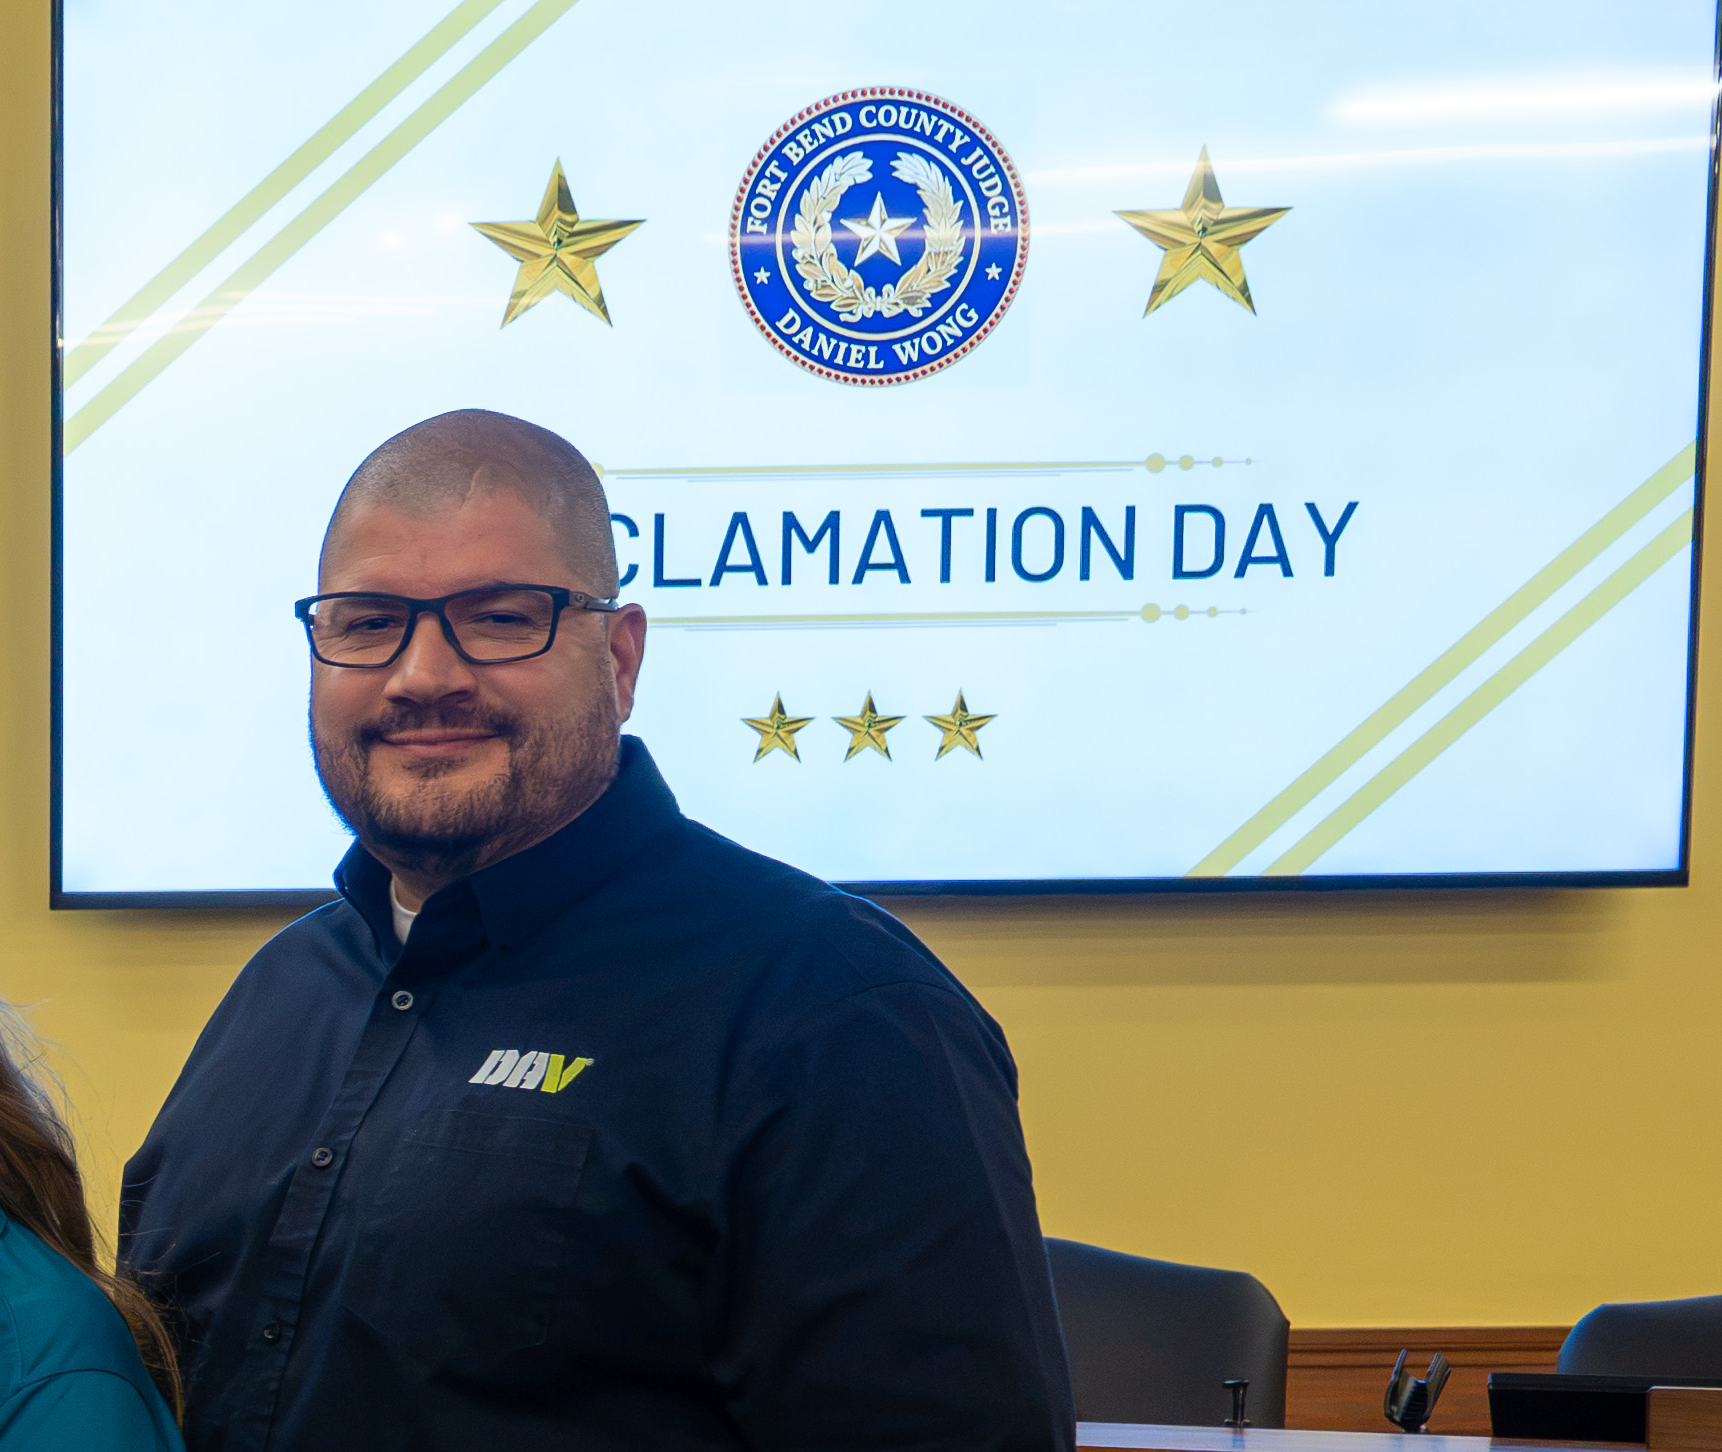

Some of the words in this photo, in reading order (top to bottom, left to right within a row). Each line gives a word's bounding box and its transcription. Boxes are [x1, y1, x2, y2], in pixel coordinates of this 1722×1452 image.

[746, 163, 787, 236] FORT
[782, 112, 854, 167] BEND
[859, 105, 971, 151] COUNTY
[960, 146, 1011, 235] JUDGE
[775, 307, 885, 369] DANIEL
[892, 302, 979, 366] WONG
[1170, 500, 1360, 580] DAY
